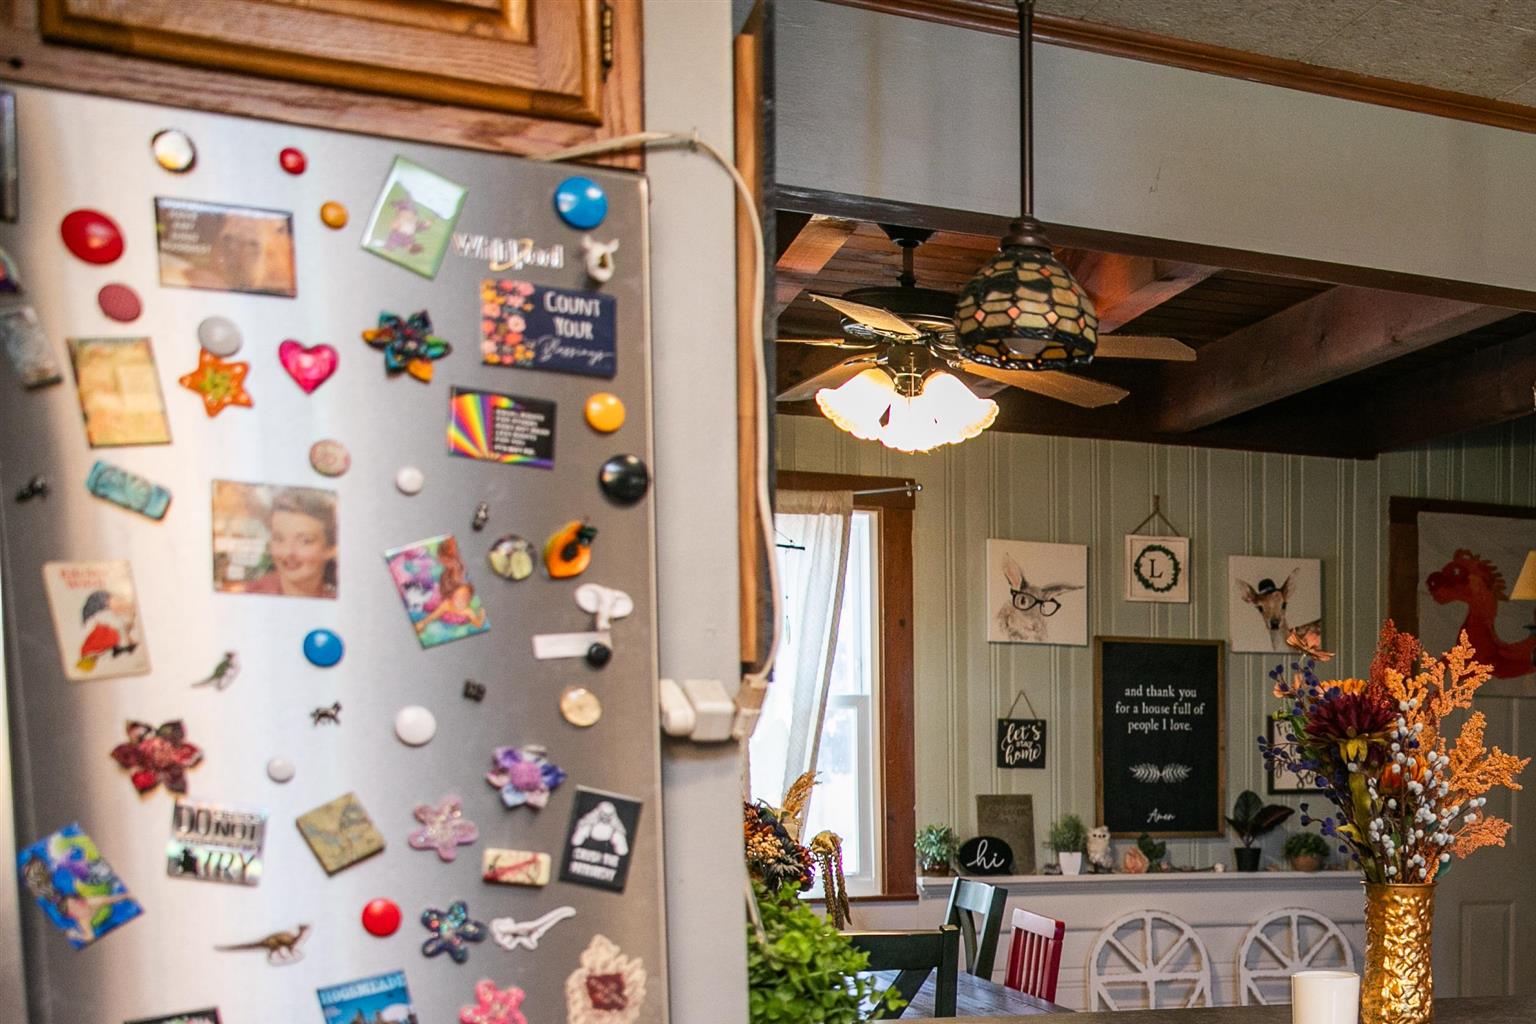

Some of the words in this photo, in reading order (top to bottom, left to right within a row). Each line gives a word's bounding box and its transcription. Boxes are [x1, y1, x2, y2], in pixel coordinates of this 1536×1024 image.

[543, 290, 601, 318] COUNT
[552, 316, 594, 340] YOUR
[1149, 558, 1164, 578] L
[1124, 684, 1143, 696] and
[1146, 684, 1175, 697] thank
[1178, 688, 1197, 701] you
[1115, 701, 1130, 714] for
[1133, 705, 1139, 714] a
[1142, 702, 1171, 714] house
[1173, 702, 1191, 715] full
[1193, 703, 1206, 715] of
[1006, 723, 1041, 743] let's
[1127, 718, 1159, 734] people
[1162, 718, 1167, 730] I
[1170, 718, 1193, 731] love.
[1005, 744, 1042, 765] home
[1146, 808, 1177, 824] Amen
[966, 839, 1006, 870] hi
